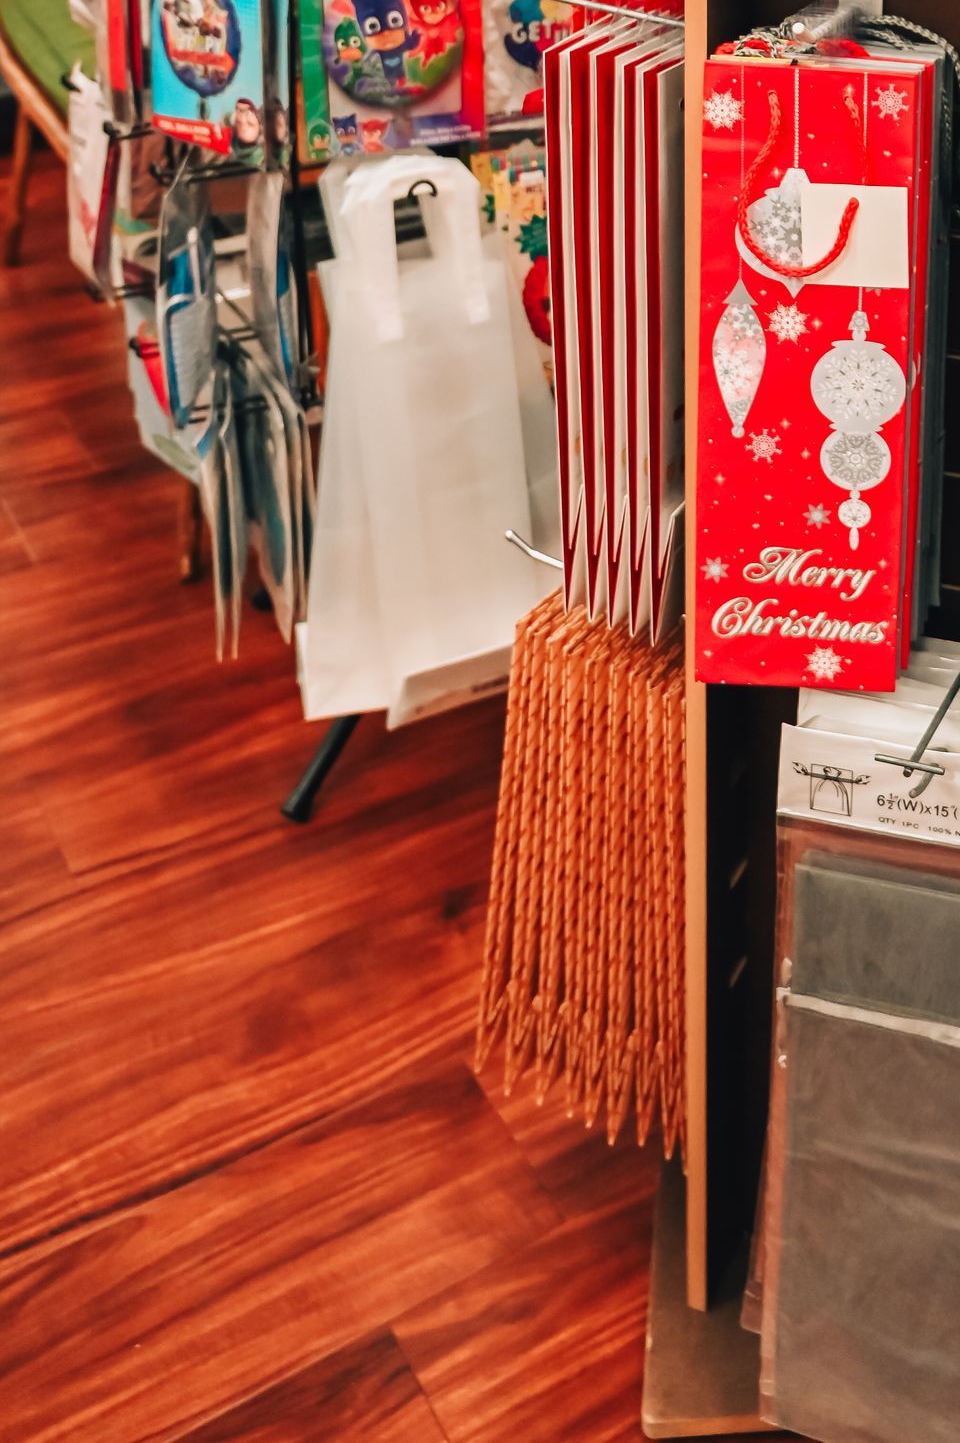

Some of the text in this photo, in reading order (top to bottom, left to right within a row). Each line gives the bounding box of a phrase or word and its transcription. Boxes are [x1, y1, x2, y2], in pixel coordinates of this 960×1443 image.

[743, 546, 877, 602] Merry
[711, 596, 889, 644] Christmas
[879, 816, 896, 827] QTY
[928, 825, 952, 836] 100%
